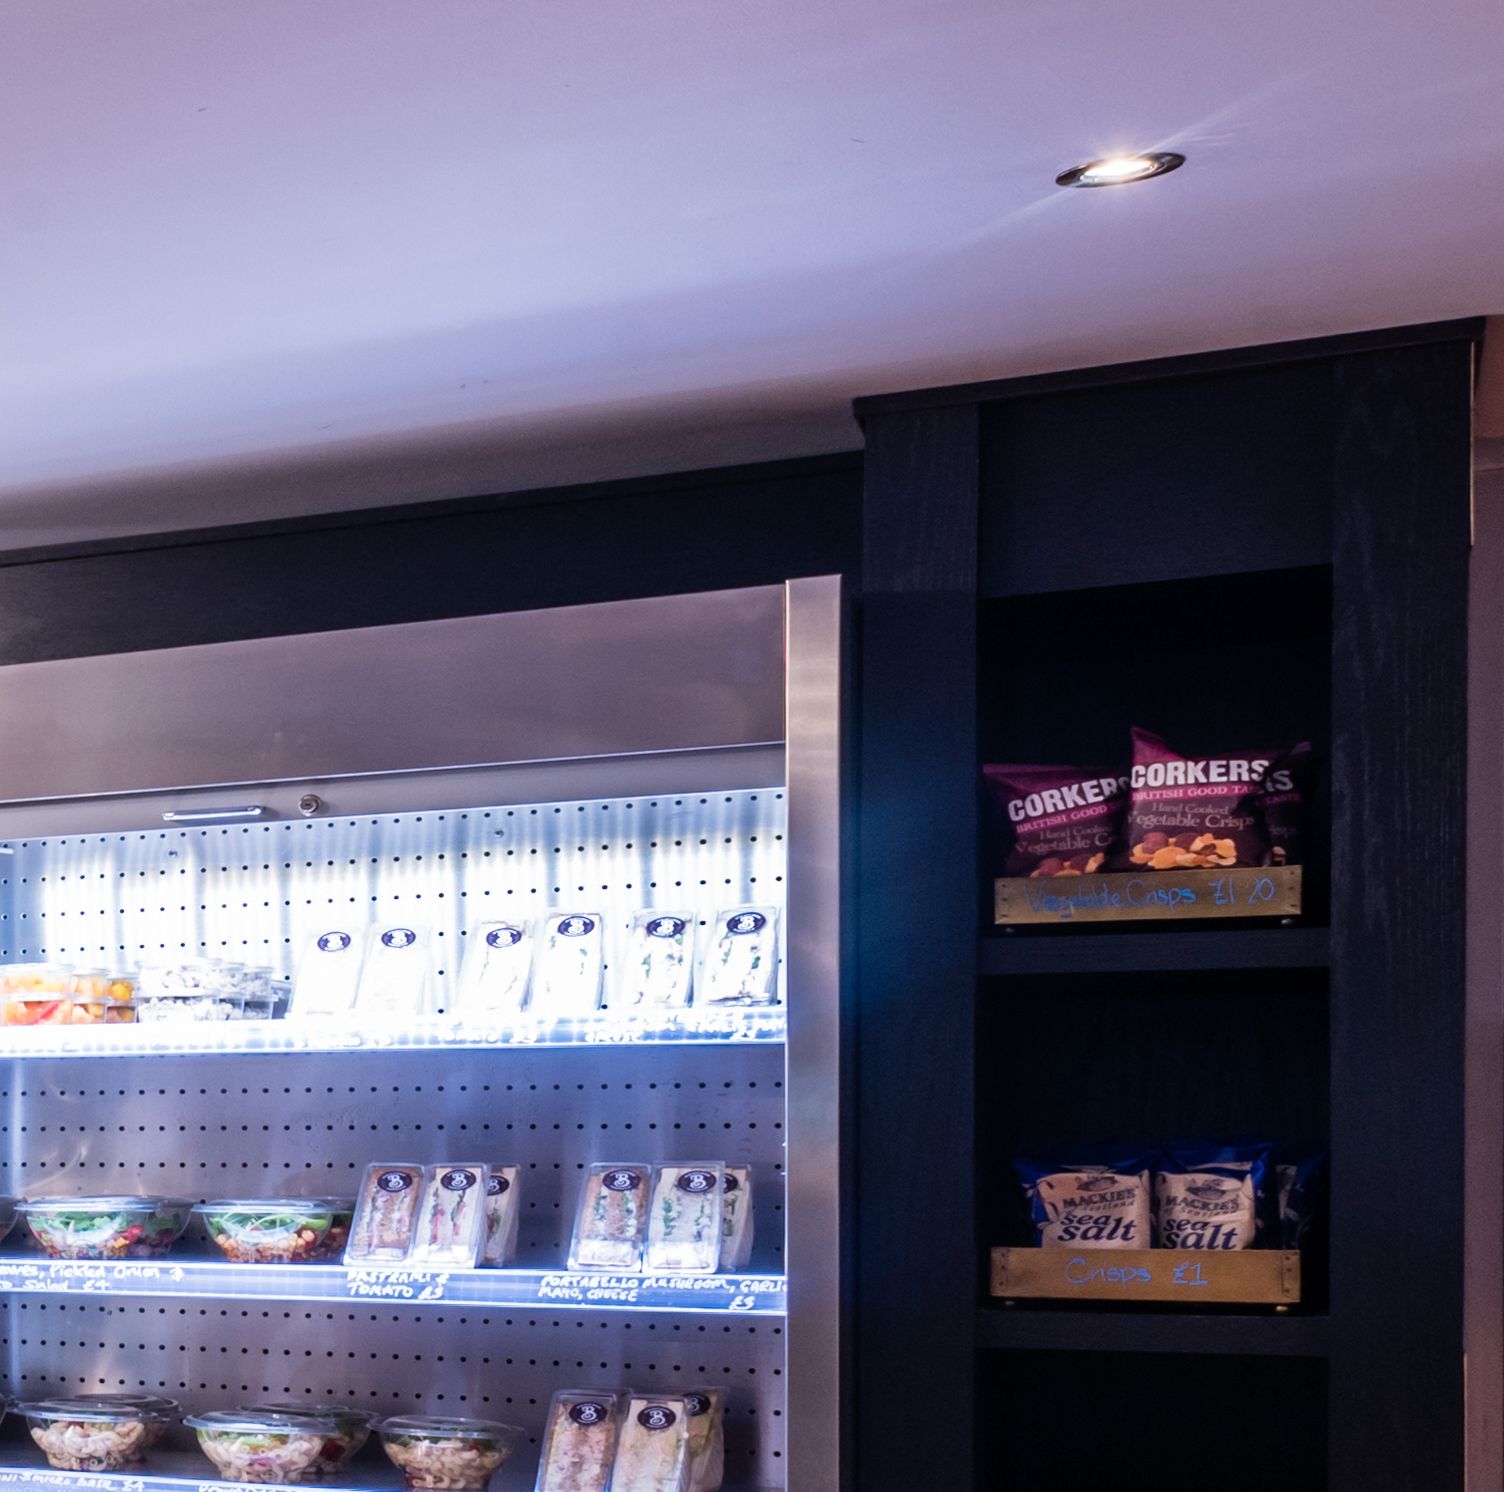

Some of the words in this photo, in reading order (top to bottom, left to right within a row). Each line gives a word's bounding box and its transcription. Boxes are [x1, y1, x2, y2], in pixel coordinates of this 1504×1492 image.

[1131, 760, 1270, 788] CORKERS
[1133, 788, 1184, 801] BRITISH
[1187, 786, 1228, 797] GOOD
[1152, 802, 1185, 815] Hand
[1186, 802, 1230, 816] Cooked
[1016, 814, 1067, 833] BRITISH
[1070, 804, 1108, 820] GOOD
[1061, 1210, 1110, 1227] sea
[1163, 1217, 1210, 1233] sea
[1058, 1218, 1138, 1243] salt
[1163, 1225, 1239, 1250] salt
[49, 1264, 106, 1278] Pickled
[113, 1265, 160, 1279] Onion
[1065, 1257, 1151, 1289] Crisps
[1172, 1262, 1208, 1286] £1
[23, 1279, 69, 1290] Salad
[346, 1281, 414, 1298] TOMATO
[540, 1276, 639, 1289] PORTABELLO
